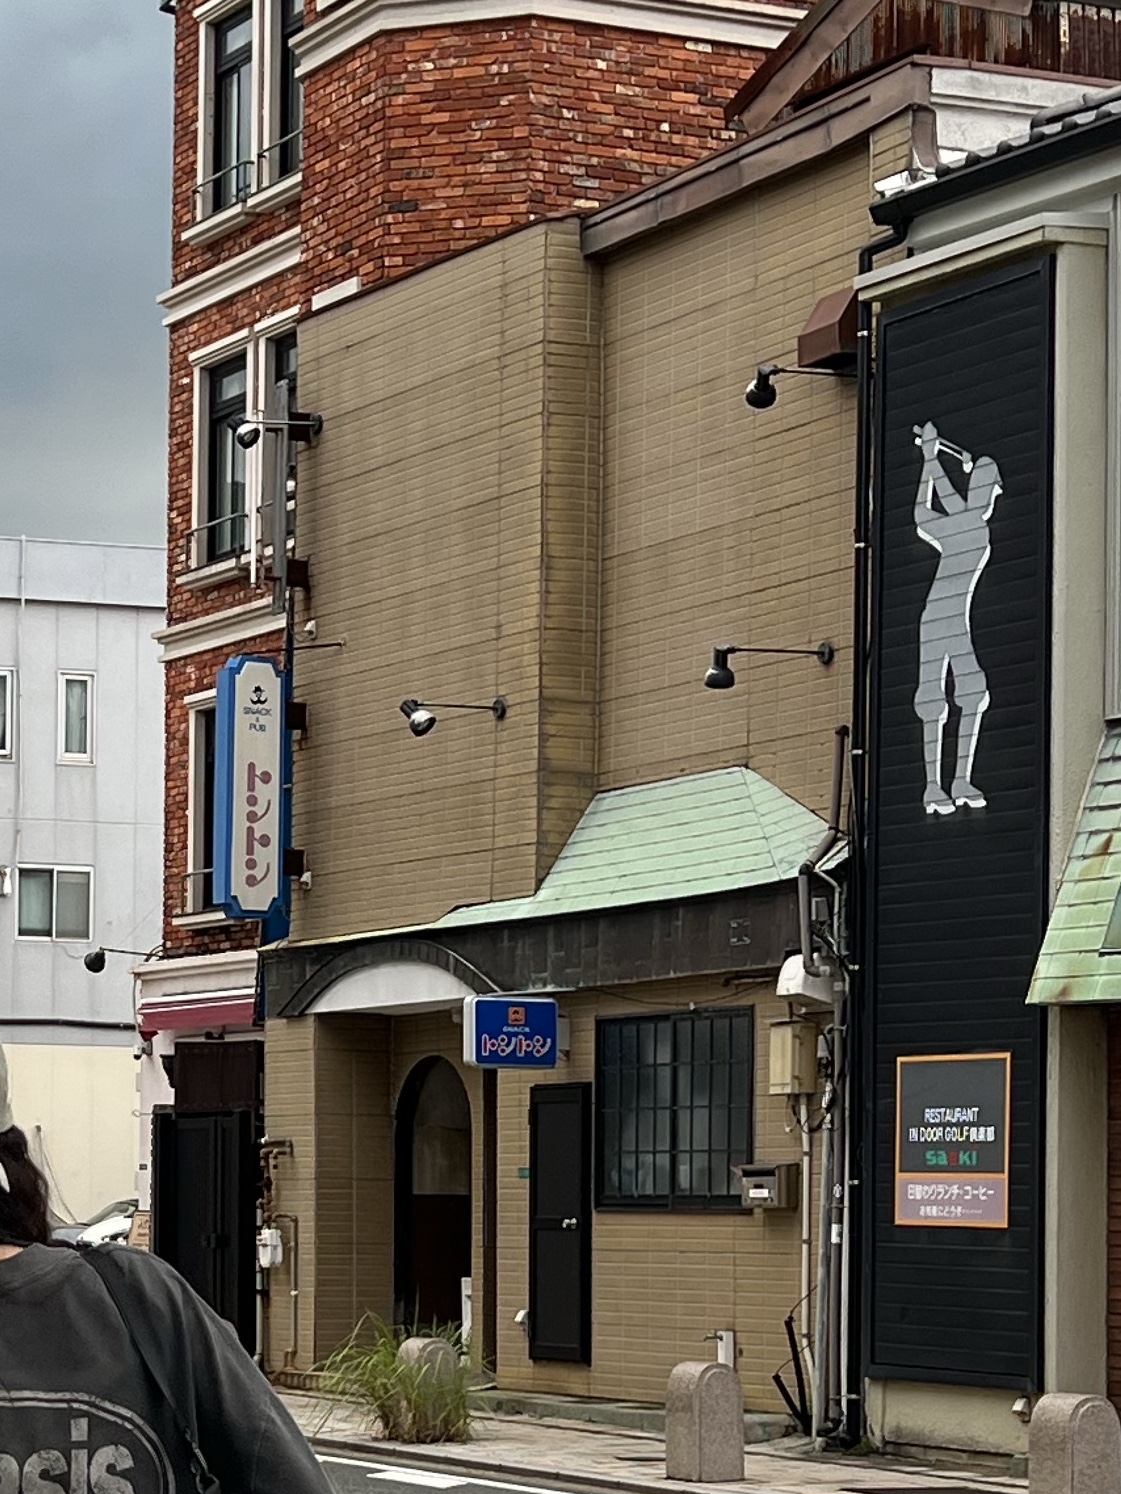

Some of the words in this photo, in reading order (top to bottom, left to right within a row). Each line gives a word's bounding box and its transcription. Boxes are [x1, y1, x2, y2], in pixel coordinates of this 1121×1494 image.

[243, 706, 272, 717] SNACK
[249, 723, 267, 732] PUB
[245, 762, 272, 888] トントン
[481, 1033, 552, 1057] トントン
[924, 1107, 979, 1123] RESTAURANT
